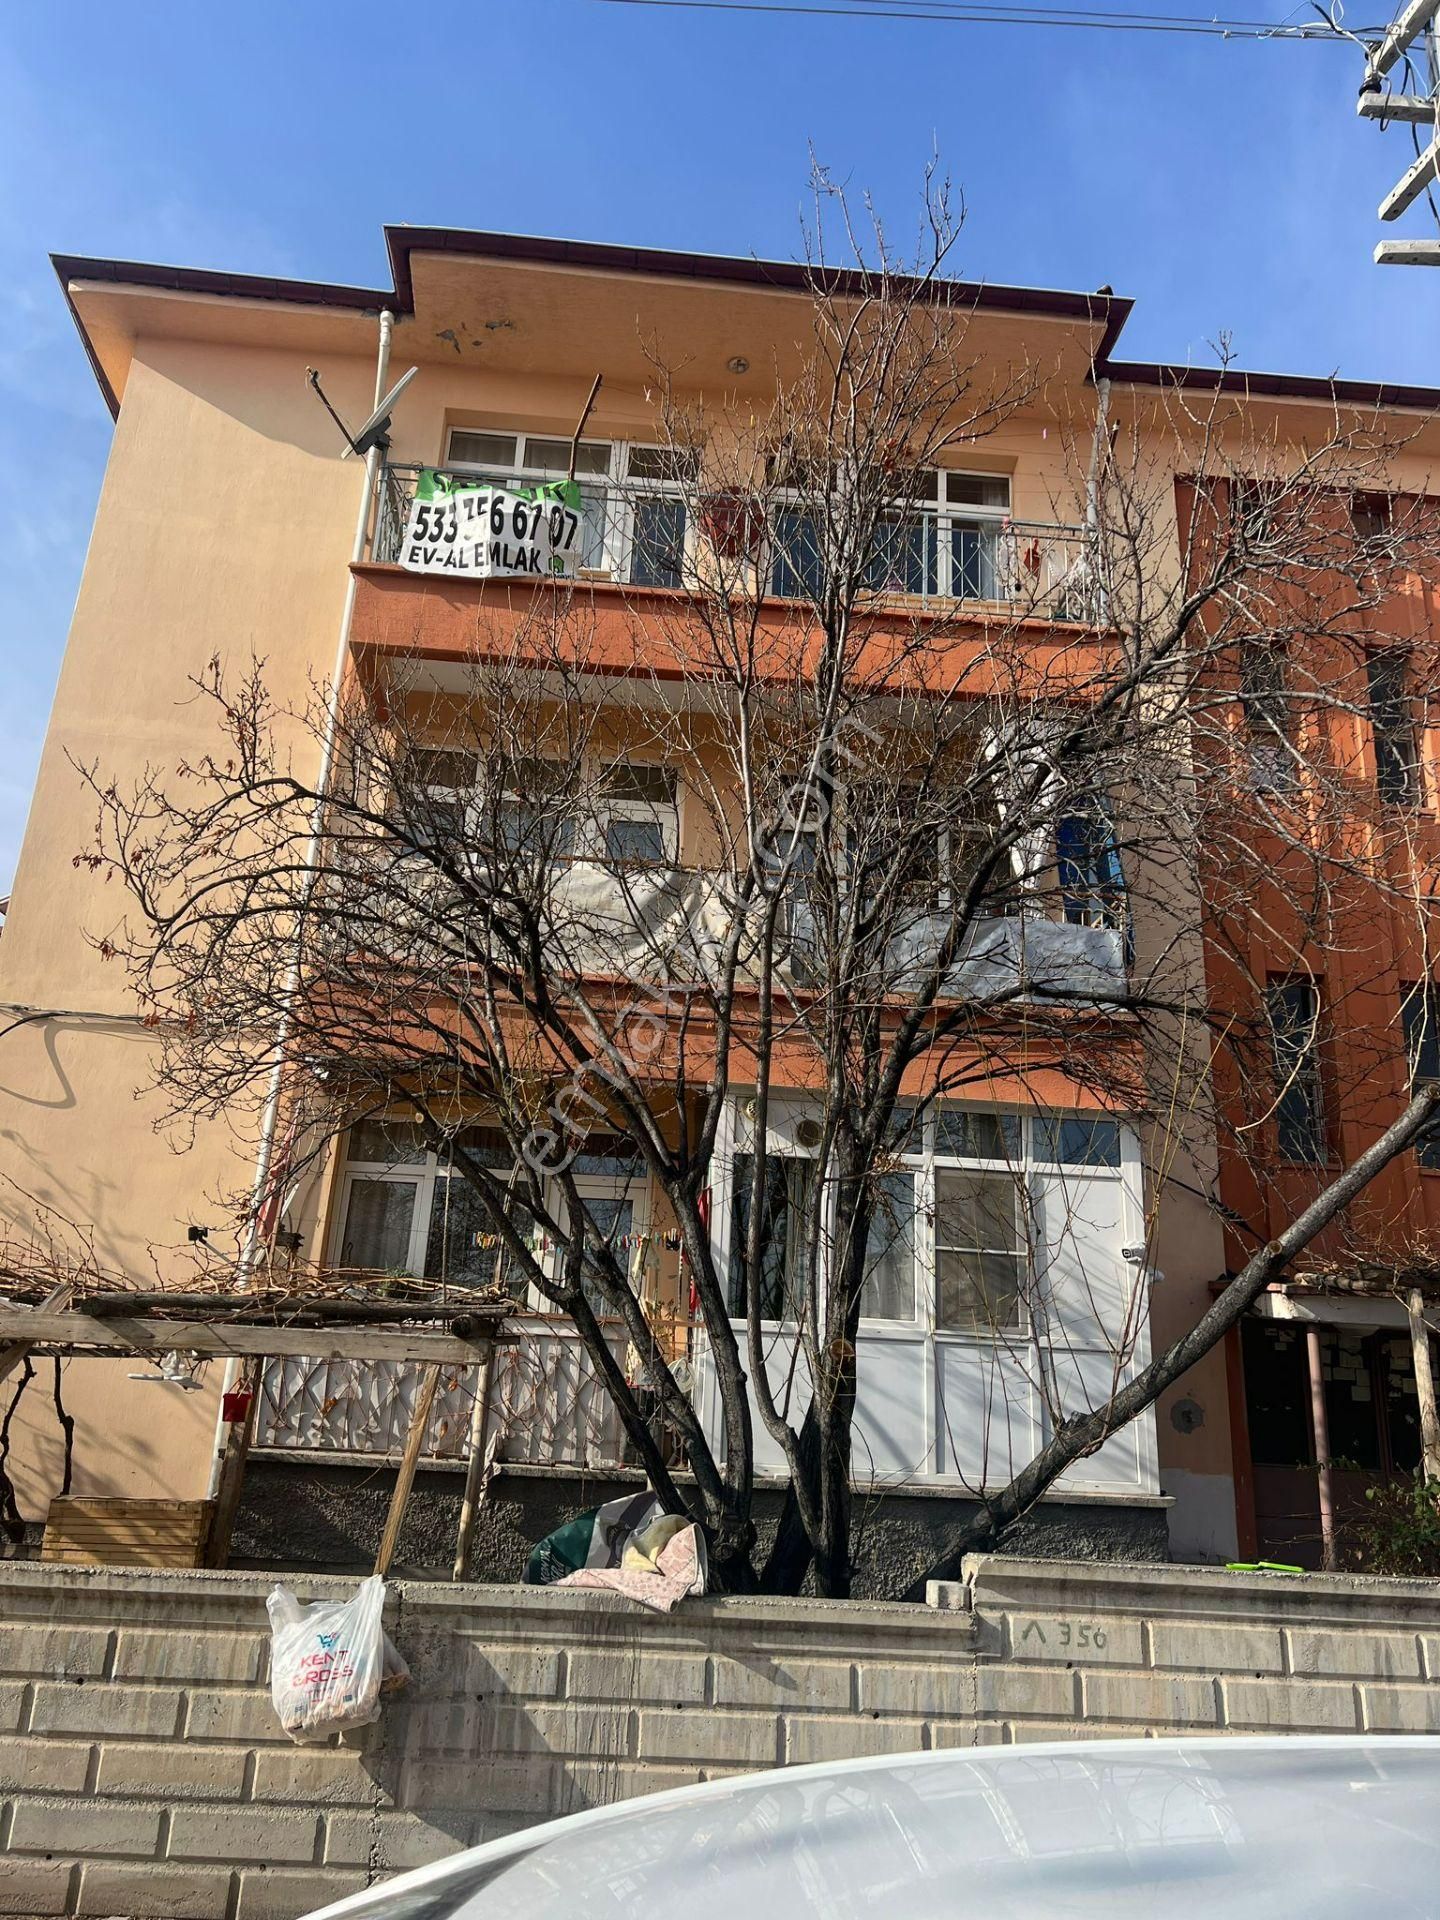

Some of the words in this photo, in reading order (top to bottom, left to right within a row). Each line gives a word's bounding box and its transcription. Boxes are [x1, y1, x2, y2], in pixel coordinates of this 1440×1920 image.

[412, 505, 458, 544] 533
[550, 505, 578, 550] 07
[408, 545, 469, 569] EV-AL
[474, 542, 542, 574] EMLAK
[301, 1650, 348, 1668] KENT
